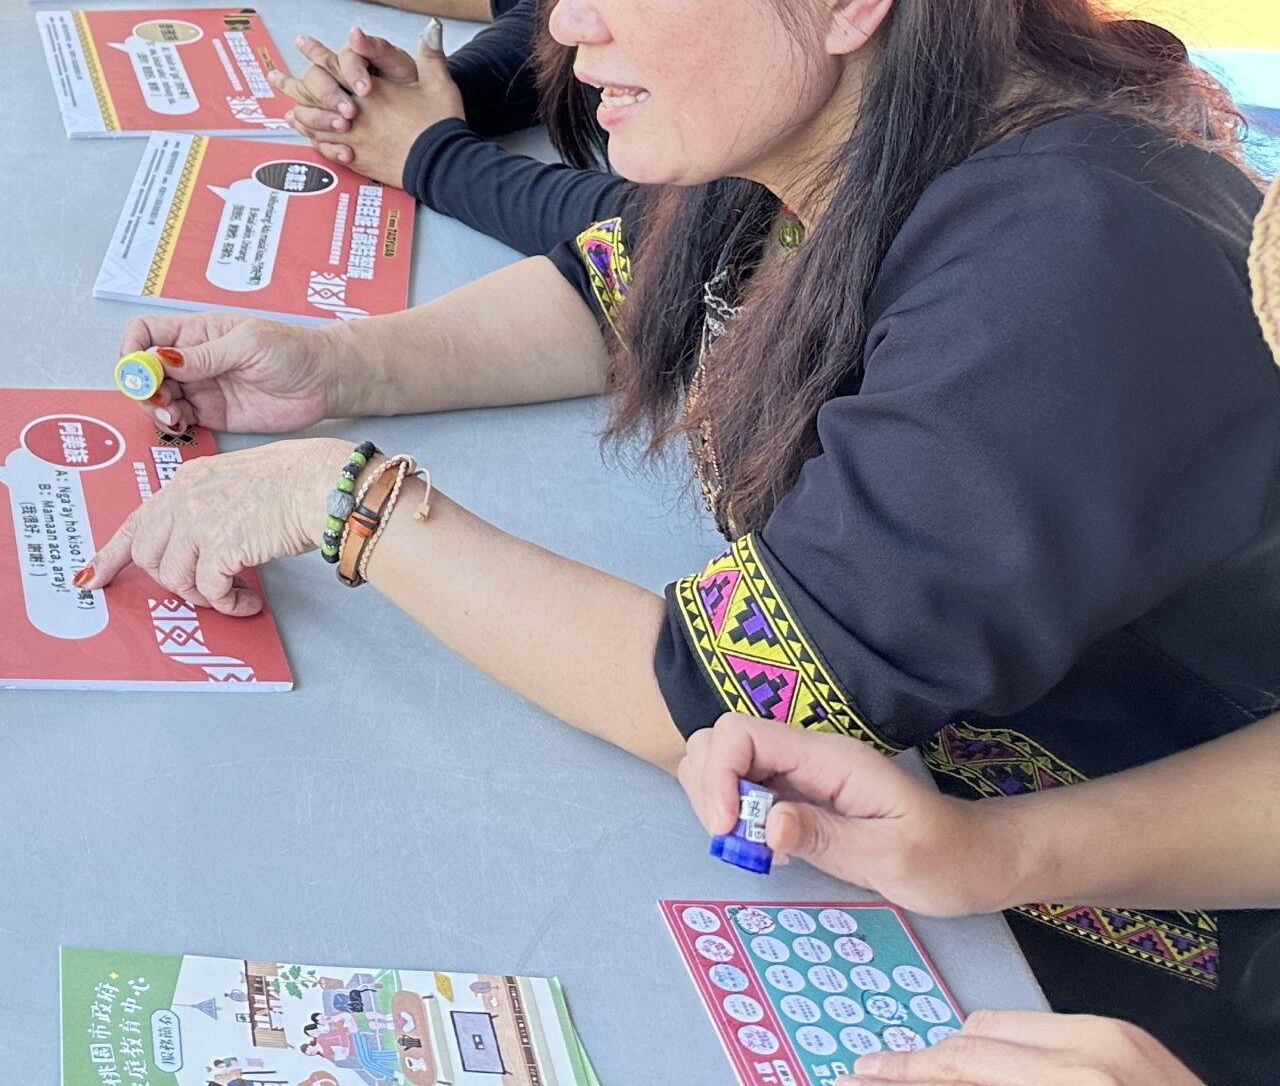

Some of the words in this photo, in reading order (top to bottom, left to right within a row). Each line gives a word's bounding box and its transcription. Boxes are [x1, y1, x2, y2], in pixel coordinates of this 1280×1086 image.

[57, 422, 90, 463] 阿美族
[150, 446, 183, 489] 原住
[40, 500, 61, 541] Mamaan
[55, 486, 74, 519] Nga'ay
[64, 520, 78, 533] ho
[47, 543, 60, 564] aca,
[69, 535, 86, 556] kiso
[51, 565, 71, 594] aray!
[88, 982, 123, 1086] 桃園市政府
[158, 1014, 176, 1065] 服務簡介
